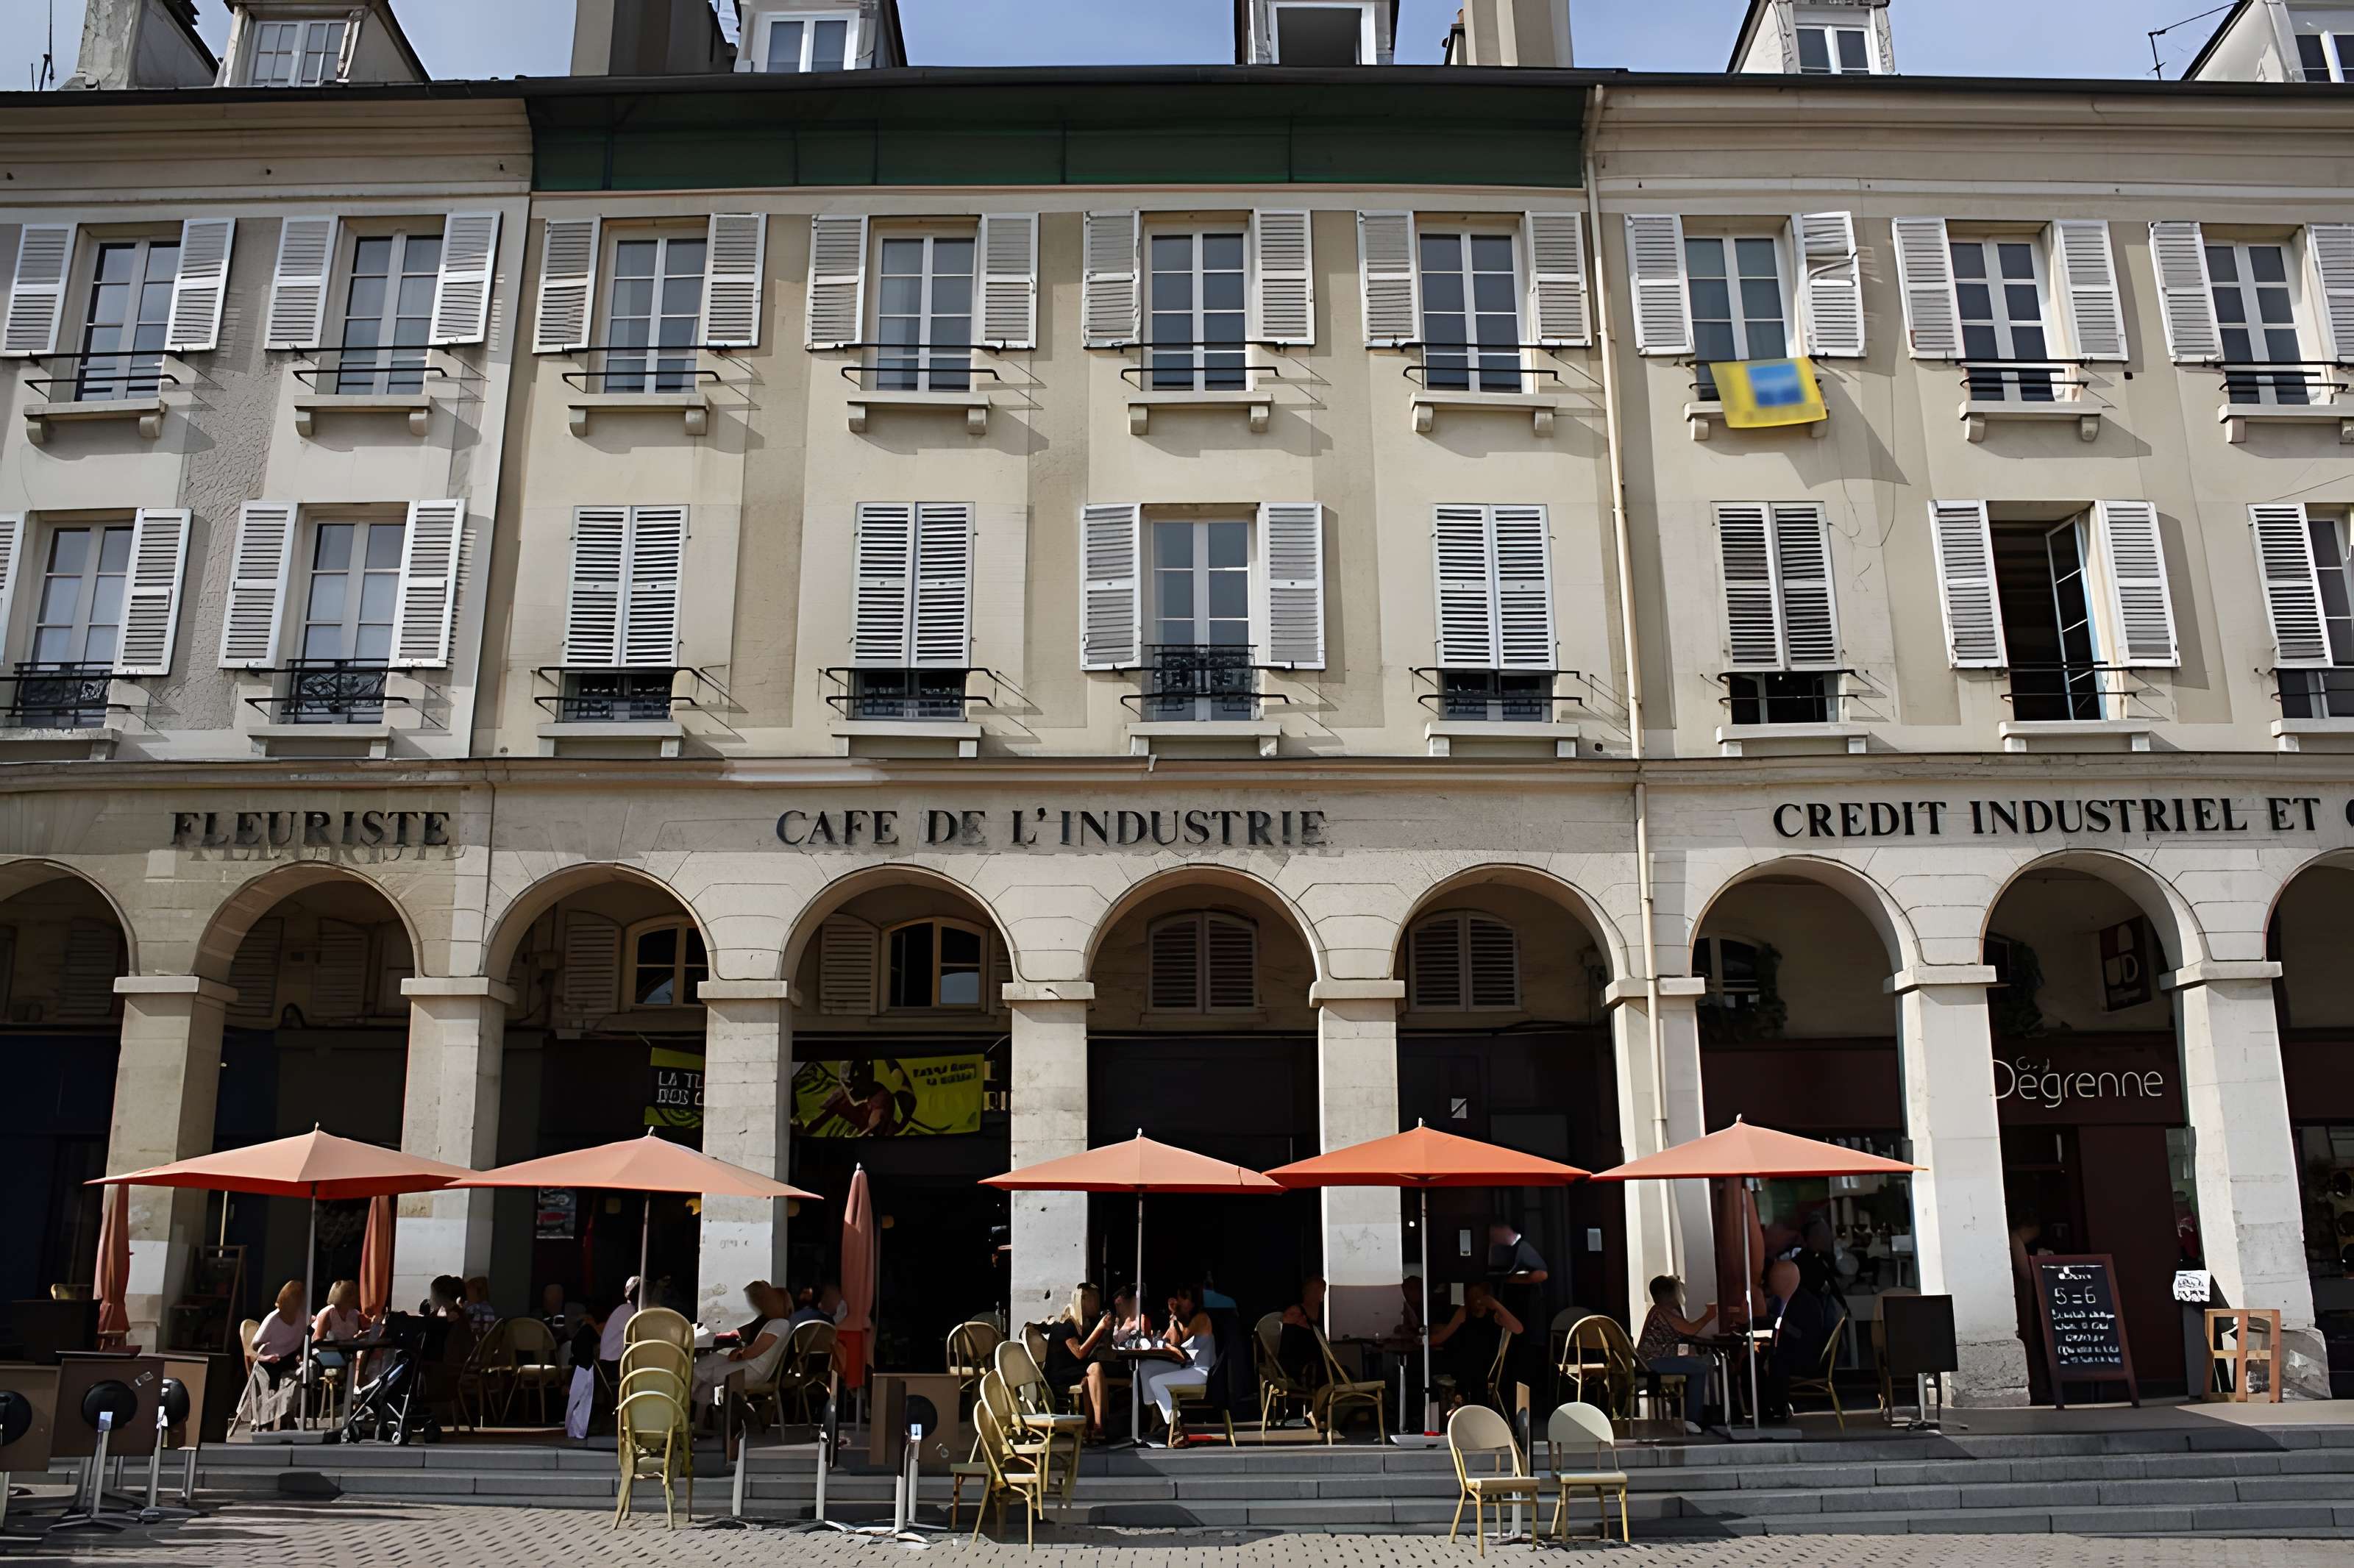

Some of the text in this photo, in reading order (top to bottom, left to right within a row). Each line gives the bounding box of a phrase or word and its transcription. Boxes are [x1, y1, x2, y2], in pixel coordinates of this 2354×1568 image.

[170, 810, 450, 847] FLEURISTE
[775, 807, 1326, 846] CAFE DE L'INDUSTRIE
[1773, 801, 1946, 838] CREDIT
[1969, 797, 2247, 835] INDUSTRIEL
[2266, 797, 2320, 832] ET
[658, 1071, 678, 1086] LA
